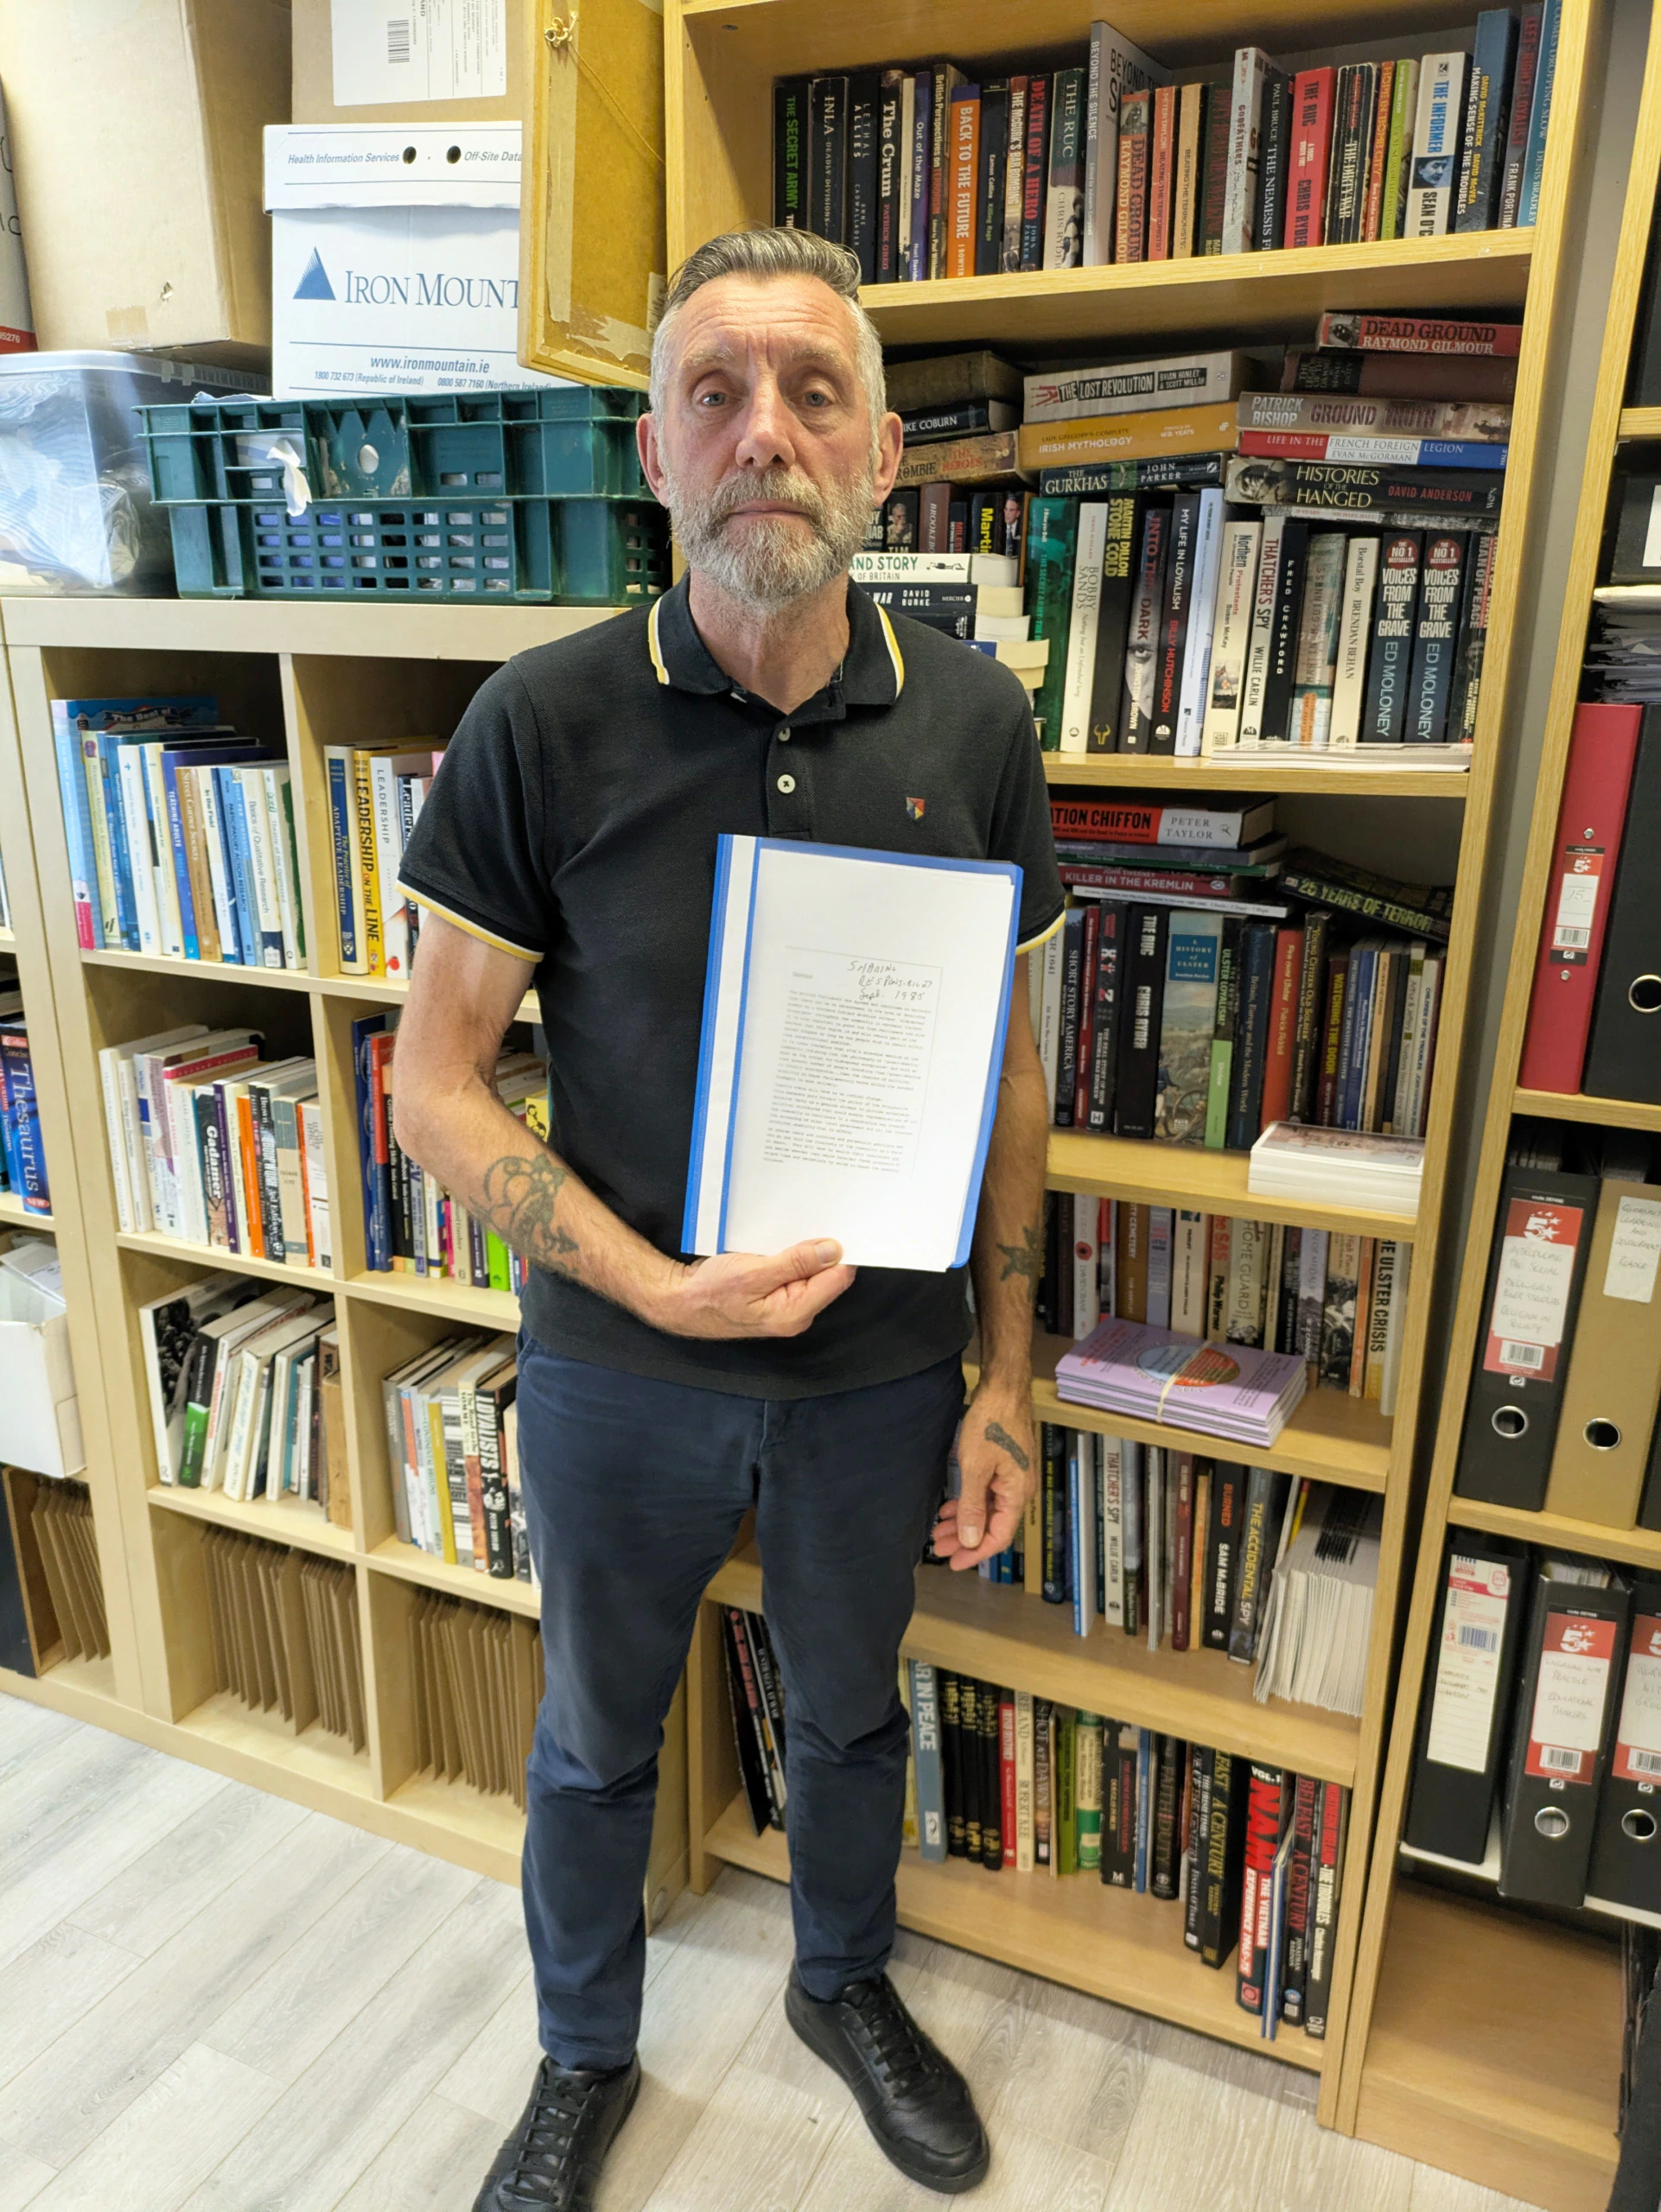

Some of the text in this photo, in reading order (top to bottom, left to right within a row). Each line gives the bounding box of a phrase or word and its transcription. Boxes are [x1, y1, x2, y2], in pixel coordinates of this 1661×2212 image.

[1012, 91, 1024, 110] THE
[1088, 41, 1099, 141] BEYOND THE SILENCE
[1301, 81, 1319, 126] THE RUC
[882, 100, 896, 139] The
[1062, 79, 1077, 159] THE RUC
[1428, 80, 1448, 154] THE INFORMER
[1473, 75, 1490, 178] DAVID DAVID
[786, 95, 799, 209] THE SECRET ARMY
[915, 142, 923, 153] of
[1457, 67, 1481, 215] MAKING SENSE OF THE TROUBLES
[288, 153, 399, 164] Health Information Services
[464, 151, 522, 161] Off-Site Data
[956, 106, 973, 239] BACK TO THE FUTURE
[1263, 178, 1276, 237] NEMESIS
[1296, 180, 1311, 214] CHRIS
[1420, 192, 1437, 218] SEAN
[345, 270, 410, 305] IRON
[1365, 321, 1497, 341] DEAD GROUND
[1363, 337, 1494, 354] RAYMOND GILMOUR
[371, 356, 489, 373] www.ironmountain.ie
[342, 373, 354, 382] 673
[355, 373, 387, 385] (Republic
[389, 375, 395, 384] of
[397, 376, 423, 386] Ireland)
[437, 377, 484, 389] 0800 587 7160
[1060, 374, 1153, 401] THE LOST REVOLUTION
[1251, 397, 1304, 411] PATRICK
[919, 416, 958, 429] COBURN
[1252, 411, 1297, 427] BISHOP
[1039, 436, 1133, 453] IRISH MYTHOLOGY
[1267, 435, 1464, 454] LIFE IN THE FRENCH FOREIGN LEGION
[1141, 472, 1182, 483] PARKER
[1147, 463, 1177, 473] JOHN
[1296, 465, 1380, 486] HISTORIES
[1045, 475, 1108, 495] GURKHAS
[1296, 487, 1372, 508] HANGED
[1388, 486, 1473, 502] DAVID ANDERSON
[877, 556, 918, 570] STORY
[1104, 541, 1119, 577] COLD
[1172, 508, 1191, 610] MY LIFE IN LOYALISM
[869, 572, 901, 581] BRITAIN
[1382, 568, 1417, 585] VOICES
[1424, 569, 1459, 586] VOICES
[1383, 586, 1412, 602] FROM
[1424, 587, 1454, 603] FROM
[1137, 598, 1152, 641] DARK
[1387, 604, 1405, 619] THE
[1429, 604, 1448, 621] THE
[1251, 607, 1271, 673] SPY WILLIE
[1378, 620, 1410, 637] GRAVE
[1419, 621, 1452, 639] GRAVE
[1161, 620, 1179, 713] BILLY HUTCHINSON
[1377, 642, 1398, 736] ED MOLONEY
[1417, 643, 1441, 740] ED MOLONEY
[111, 710, 159, 722] The Best
[168, 791, 181, 848] TEACHING ADULTS
[377, 769, 390, 844] LEADERSHIP
[1091, 809, 1152, 830] CHIFFON
[1166, 828, 1213, 839] TAYLOR
[1171, 817, 1211, 828] PETER
[333, 805, 347, 915] ADAPTIVE LEADERSHIP
[356, 778, 374, 872] LEADERSHIP
[366, 907, 379, 943] LINE
[1065, 872, 1193, 891] KILLER IN THE KREMLIN
[1569, 889, 1584, 900] 15
[1298, 878, 1381, 914] 25 YEARS OF
[1143, 916, 1157, 934] THE
[847, 961, 896, 974] SHARING
[859, 988, 925, 1001] Sept. 1985
[1066, 950, 1078, 1021] SHORT STORY
[1136, 986, 1151, 1014] CHRIS
[1326, 973, 1345, 1074] WATCHING THE DOOR
[10, 1063, 39, 1192] Thesaurus
[206, 1125, 221, 1200] Gadamer
[1238, 1221, 1253, 1310] HOME GUARD
[1371, 1257, 1394, 1352] ULSTER CRISIS
[476, 1395, 500, 1470] LOYALISTS
[1221, 1483, 1234, 1527] BURNED
[1218, 1542, 1230, 1567] SAM
[1239, 1503, 1263, 1625] THE ACCIDENTAL SPY
[918, 1703, 938, 1751] PEACE
[1245, 1777, 1282, 1872] NAM
[1207, 1811, 1229, 1880] CENTURY
[1289, 1777, 1315, 1933] BELFAST CENTURY
[1242, 1867, 1257, 1933] EXPERIENCE
